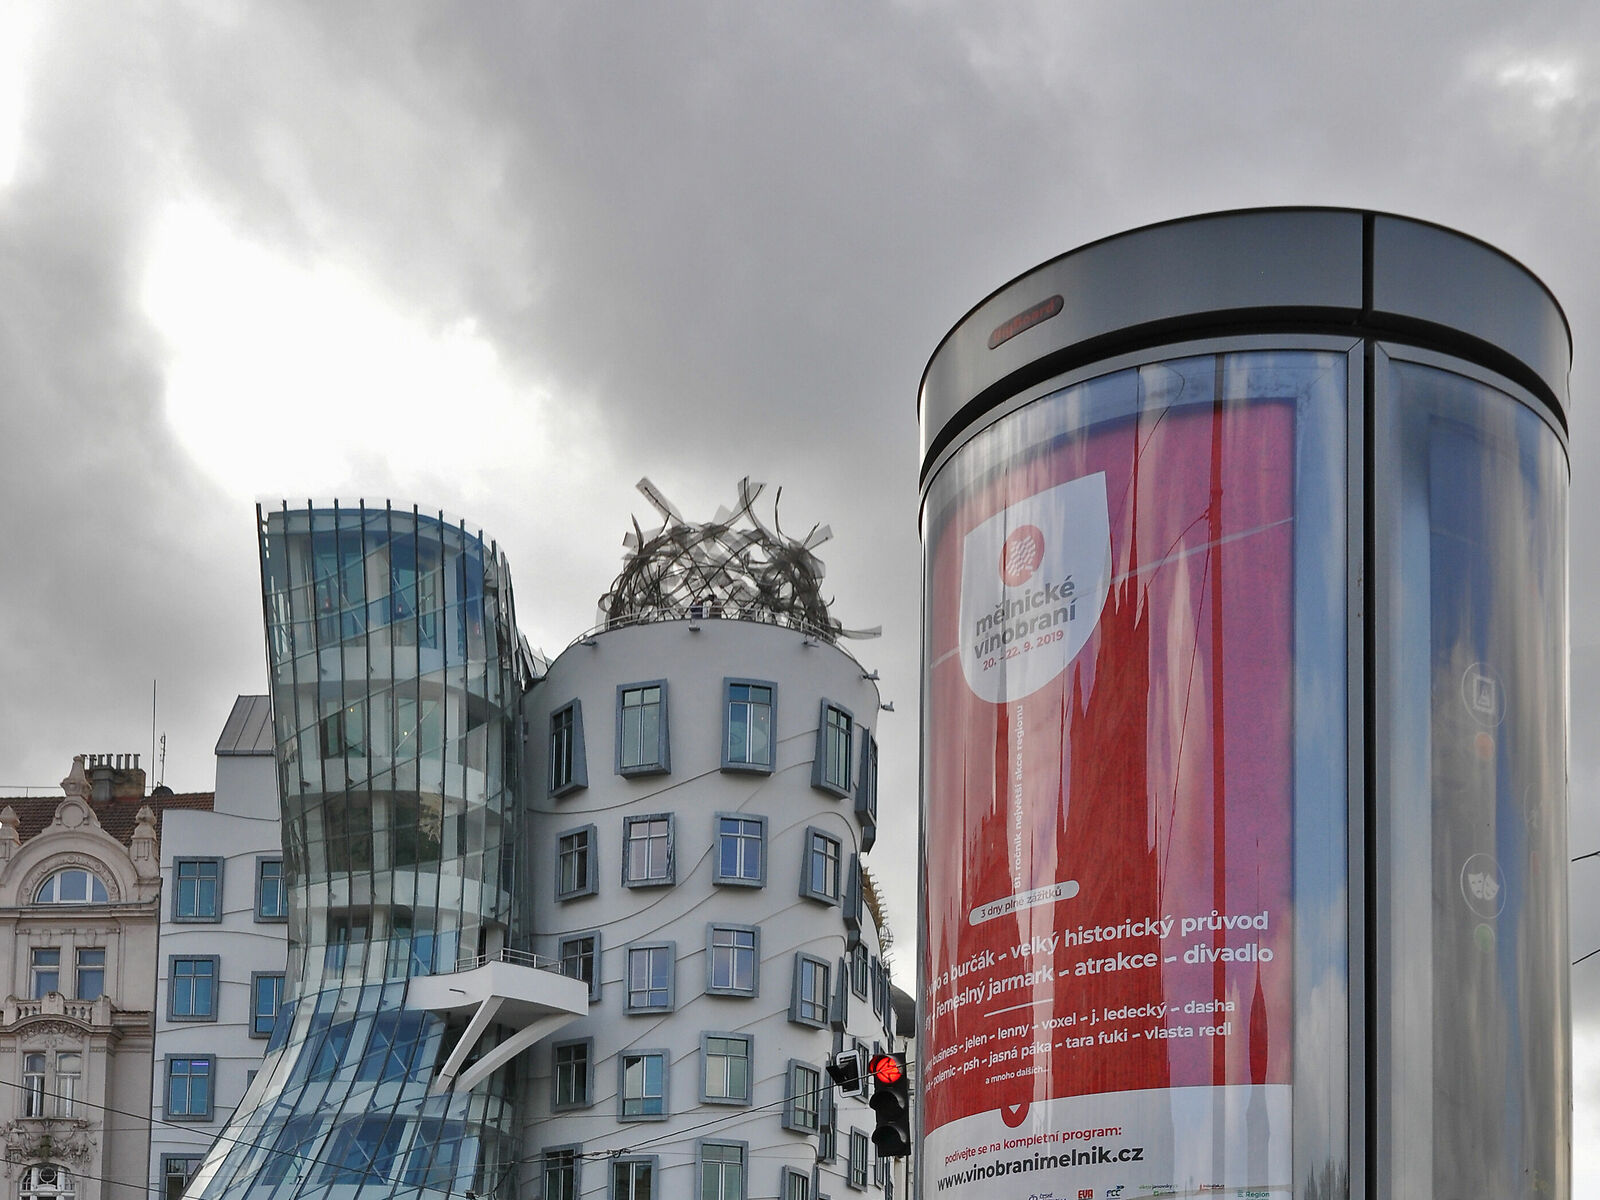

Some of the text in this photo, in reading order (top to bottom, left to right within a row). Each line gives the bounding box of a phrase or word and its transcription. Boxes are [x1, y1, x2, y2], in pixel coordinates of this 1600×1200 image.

[975, 598, 1078, 659] vinobraní
[976, 575, 1075, 637] mělnické
[983, 657, 997, 671] 20.
[1024, 641, 1034, 652] 9.
[1036, 629, 1064, 648] 2019
[980, 909, 986, 918] 3
[988, 904, 1003, 915] dny
[943, 972, 949, 985] a
[951, 949, 995, 981] burčák
[1011, 931, 1059, 959] velký
[1065, 914, 1175, 948] historický
[1181, 910, 1269, 936] průvod
[936, 981, 986, 1019] řemeslný
[987, 964, 1054, 1001] jarmark
[1074, 951, 1158, 977] atrakce
[1183, 943, 1274, 964] divadlo
[932, 1043, 958, 1065] business
[965, 1033, 987, 1053] jelen
[997, 1024, 1030, 1040] lenny
[1042, 1012, 1077, 1030] voxel
[1089, 1009, 1100, 1026] j.
[1103, 1001, 1167, 1021] ledecký
[1184, 999, 1236, 1014] dasha
[963, 1056, 980, 1075] psh
[988, 1045, 1018, 1068] jasná
[1021, 1041, 1052, 1060] páka
[1066, 1033, 1094, 1050] tara
[1098, 1028, 1128, 1046] fuki
[1144, 1024, 1194, 1041] vlasta
[1199, 1021, 1233, 1037] redl
[985, 1077, 990, 1085] a
[990, 1071, 1015, 1083] mnoho
[937, 1145, 1145, 1192] www.vinobranimelnik.cz
[945, 1126, 1122, 1167] podívejte se na kompletní program:
